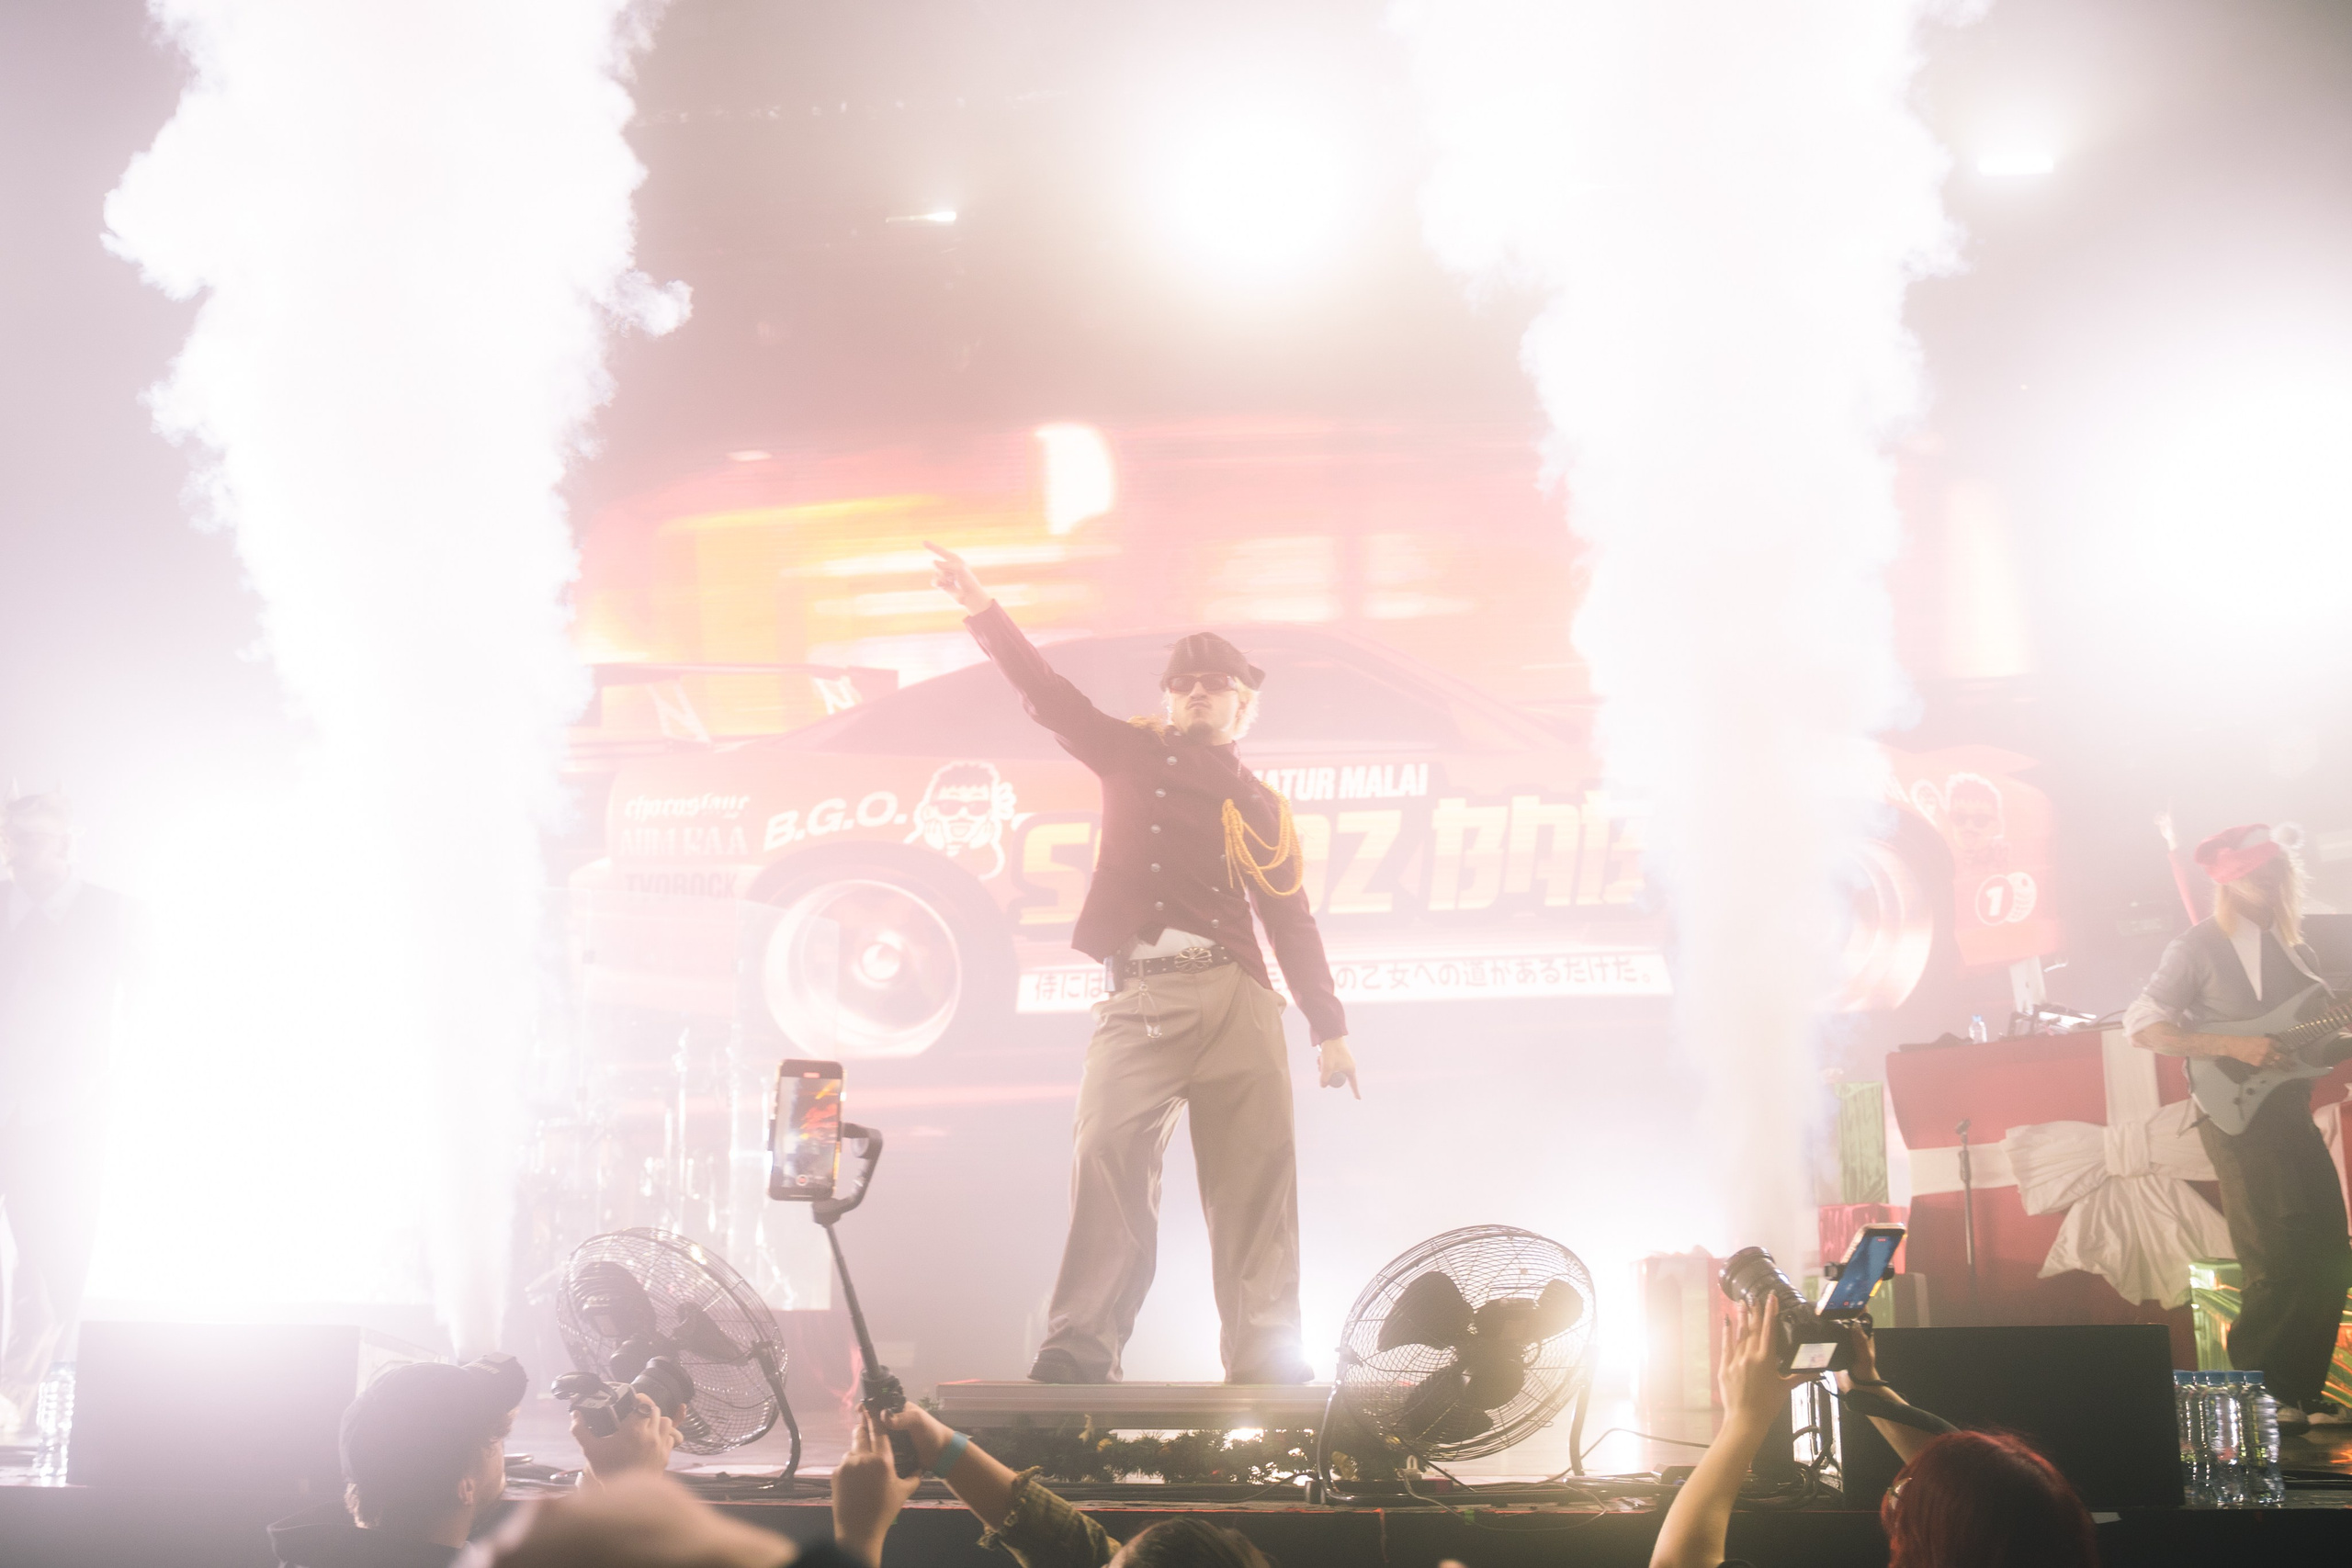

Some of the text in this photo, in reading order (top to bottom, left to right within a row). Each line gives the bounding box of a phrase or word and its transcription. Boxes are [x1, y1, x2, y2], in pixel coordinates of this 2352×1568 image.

[1339, 763, 1428, 798] MALAI
[763, 791, 908, 852] B.G.O.
[1985, 886, 2004, 917] 1
